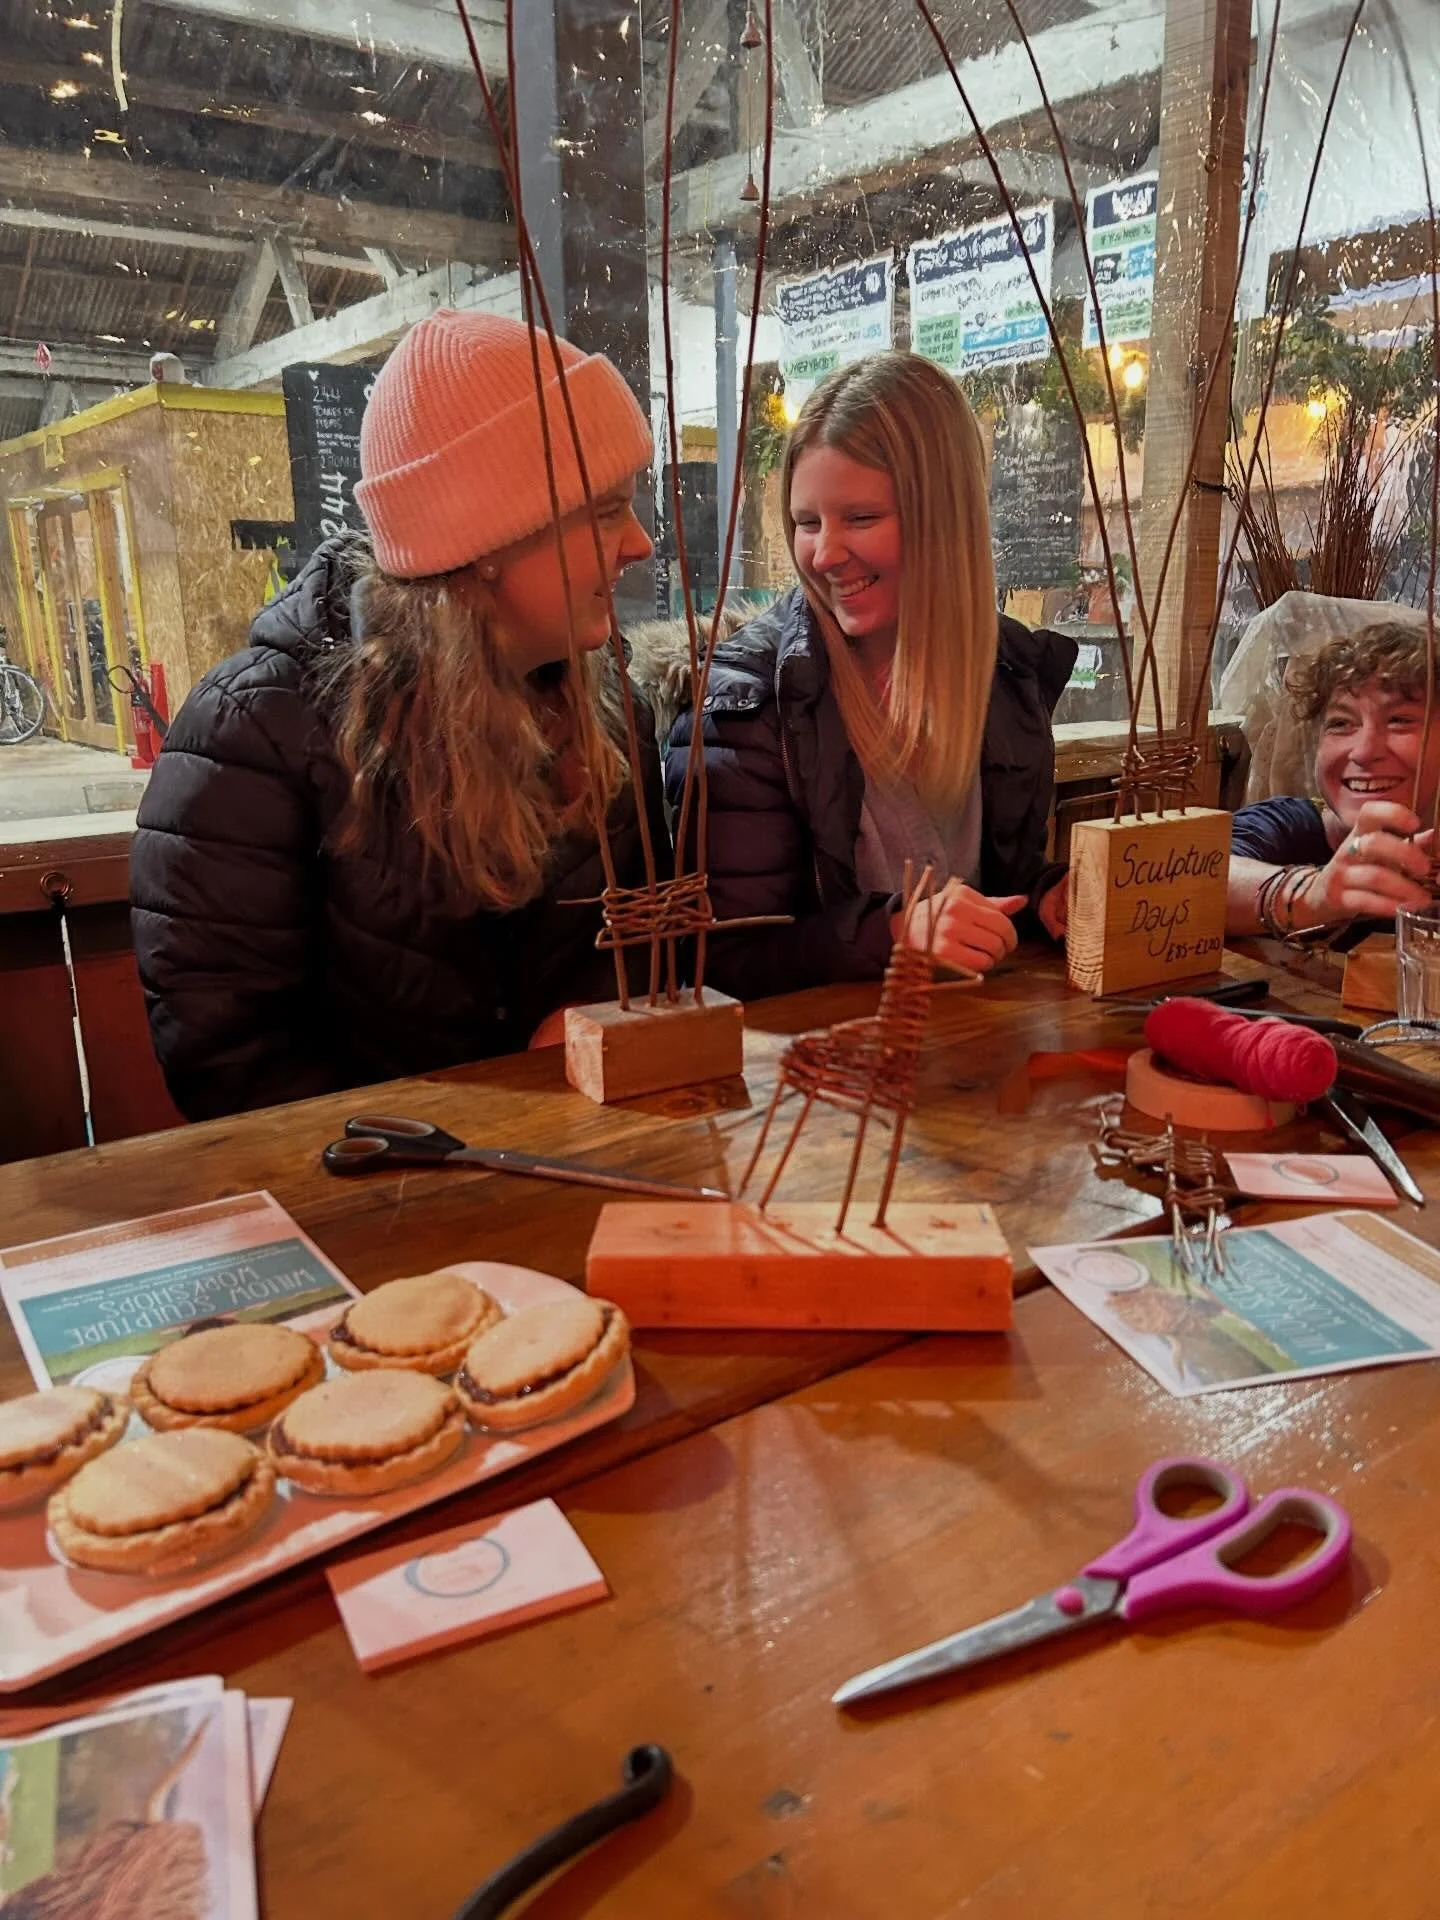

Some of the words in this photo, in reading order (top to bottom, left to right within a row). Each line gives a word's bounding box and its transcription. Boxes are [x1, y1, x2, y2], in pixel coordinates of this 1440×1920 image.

[312, 385, 341, 402] 244
[319, 471, 351, 537] 244
[1115, 843, 1225, 888] Sculpture
[1125, 899, 1190, 957] Days
[98, 1266, 261, 1319] WORKSHOPS
[228, 1267, 317, 1307] WILLOW
[65, 1293, 216, 1349] SCULPTURE
